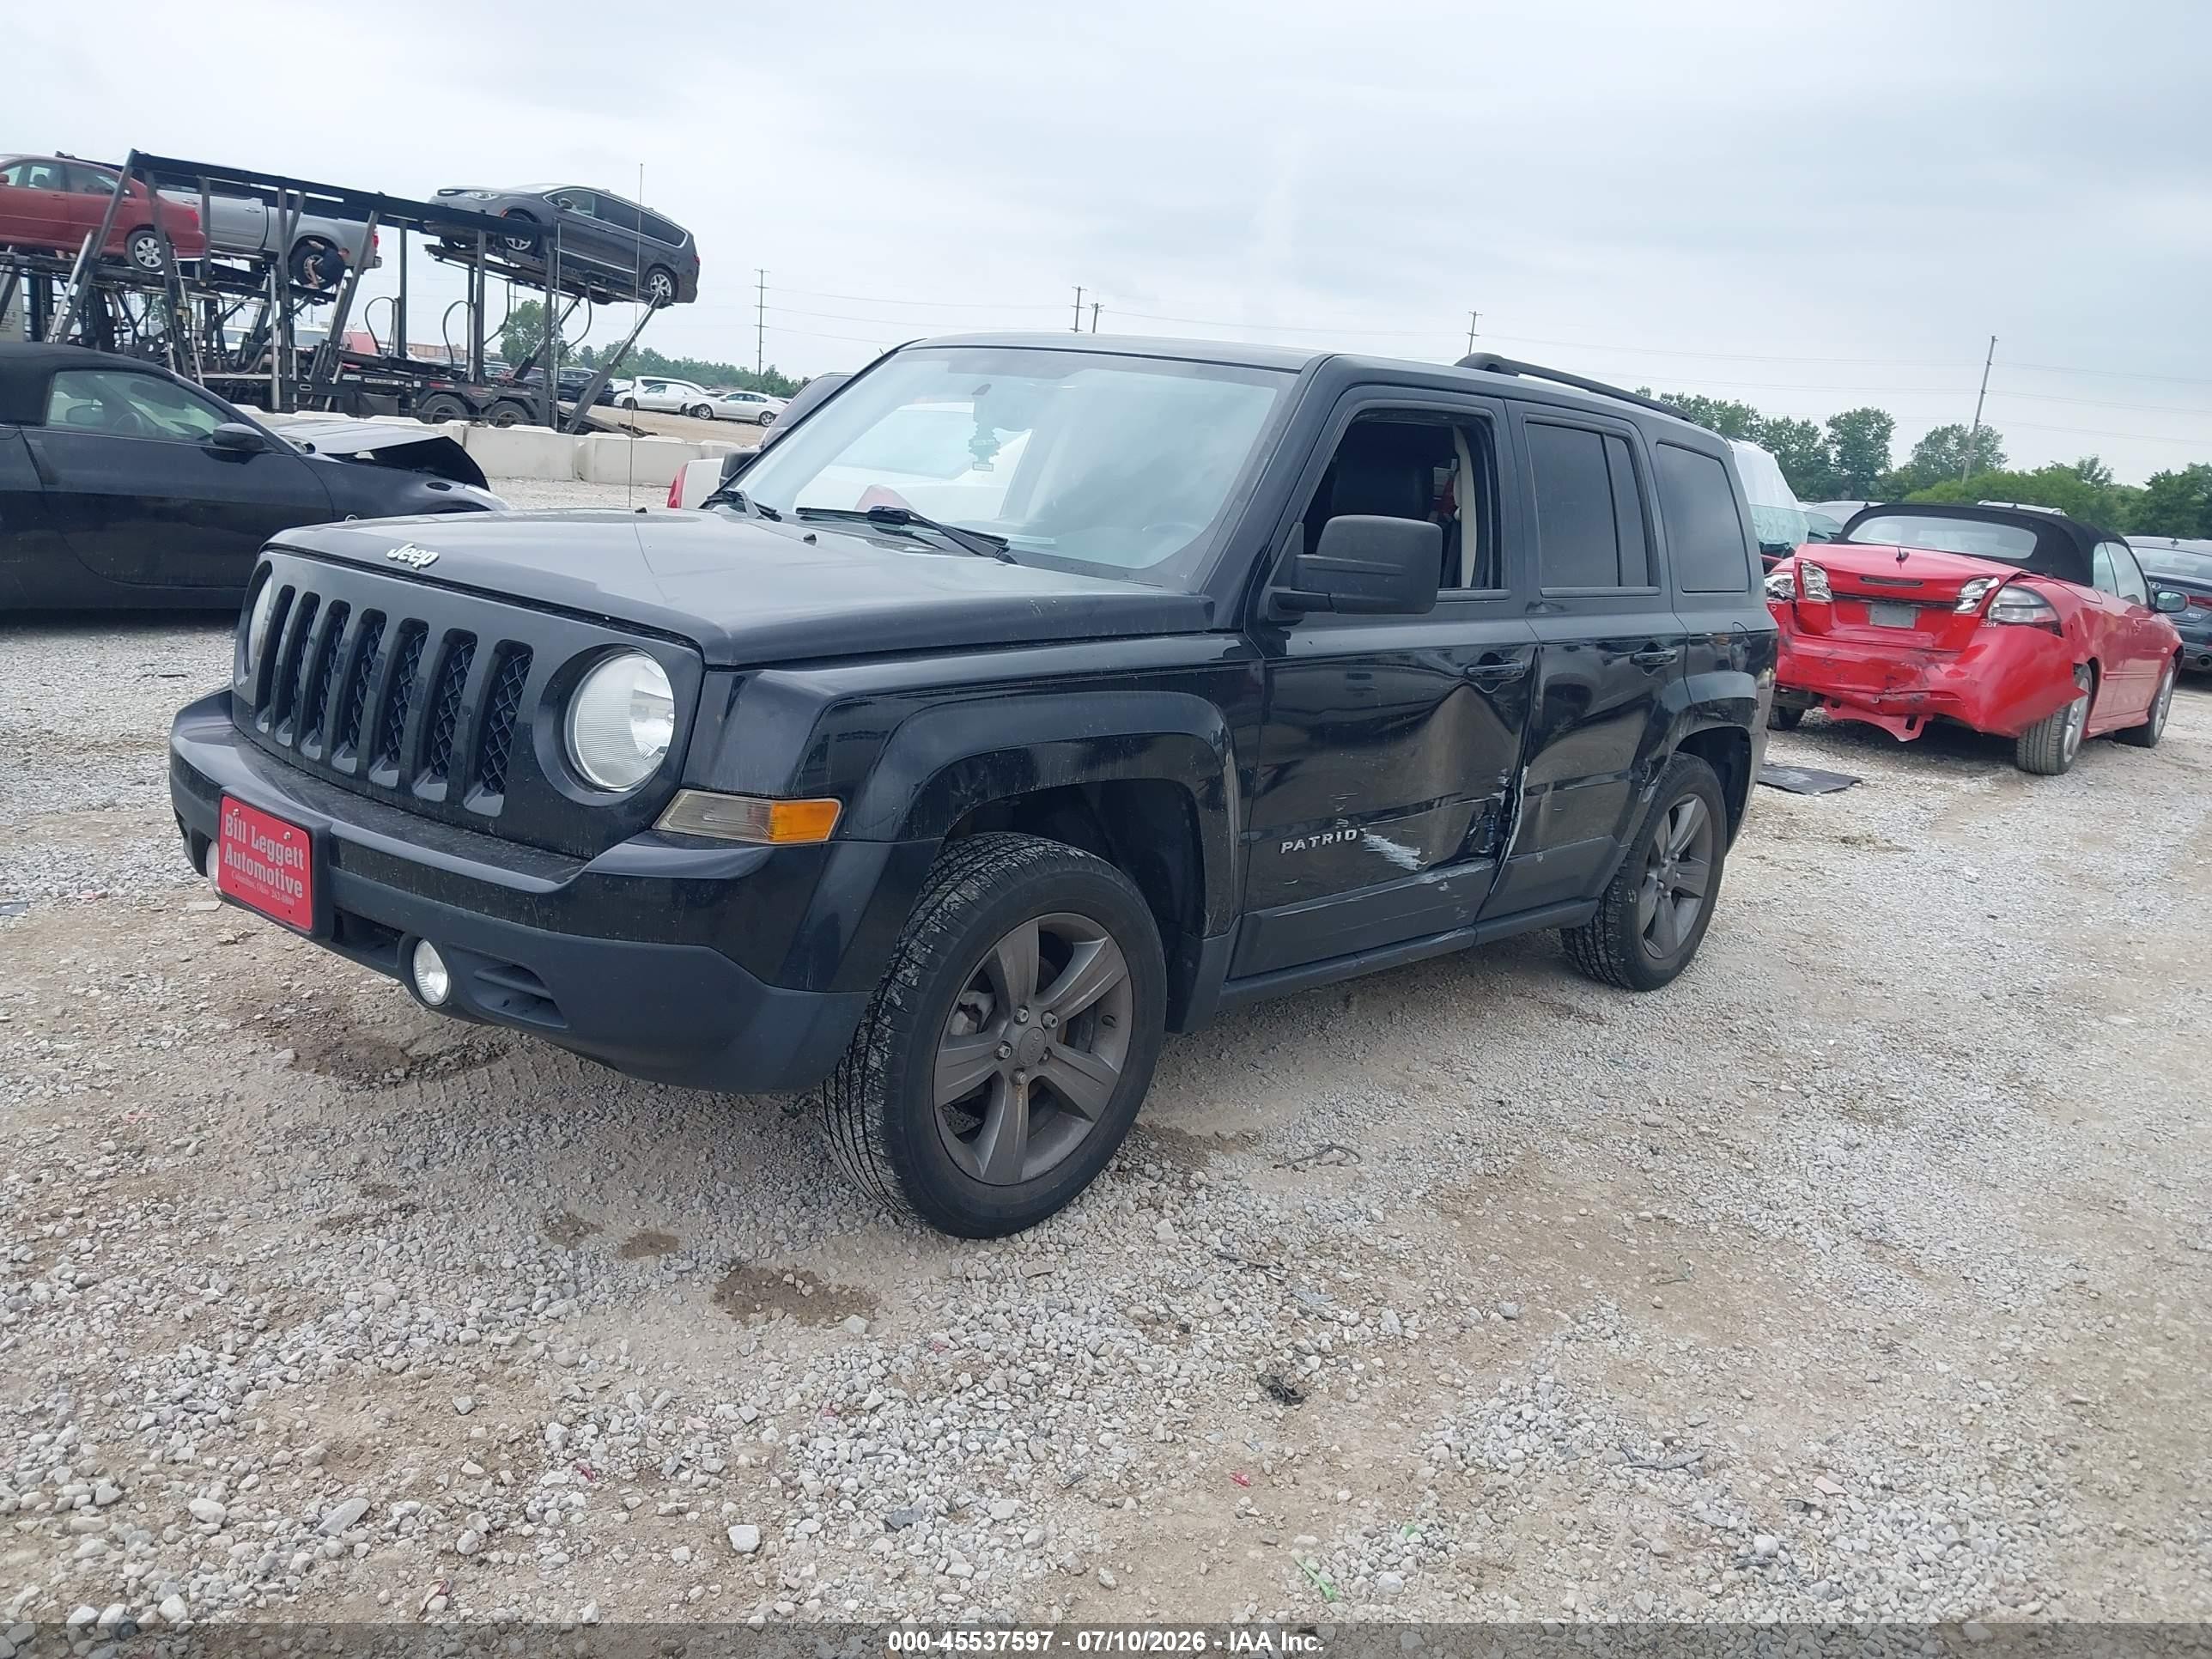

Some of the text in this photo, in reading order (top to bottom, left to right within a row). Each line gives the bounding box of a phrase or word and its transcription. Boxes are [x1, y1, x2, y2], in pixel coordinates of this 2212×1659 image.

[386, 543, 440, 570] Jeep
[224, 813, 305, 871] Bill Leggett
[224, 842, 303, 899] Automotive
